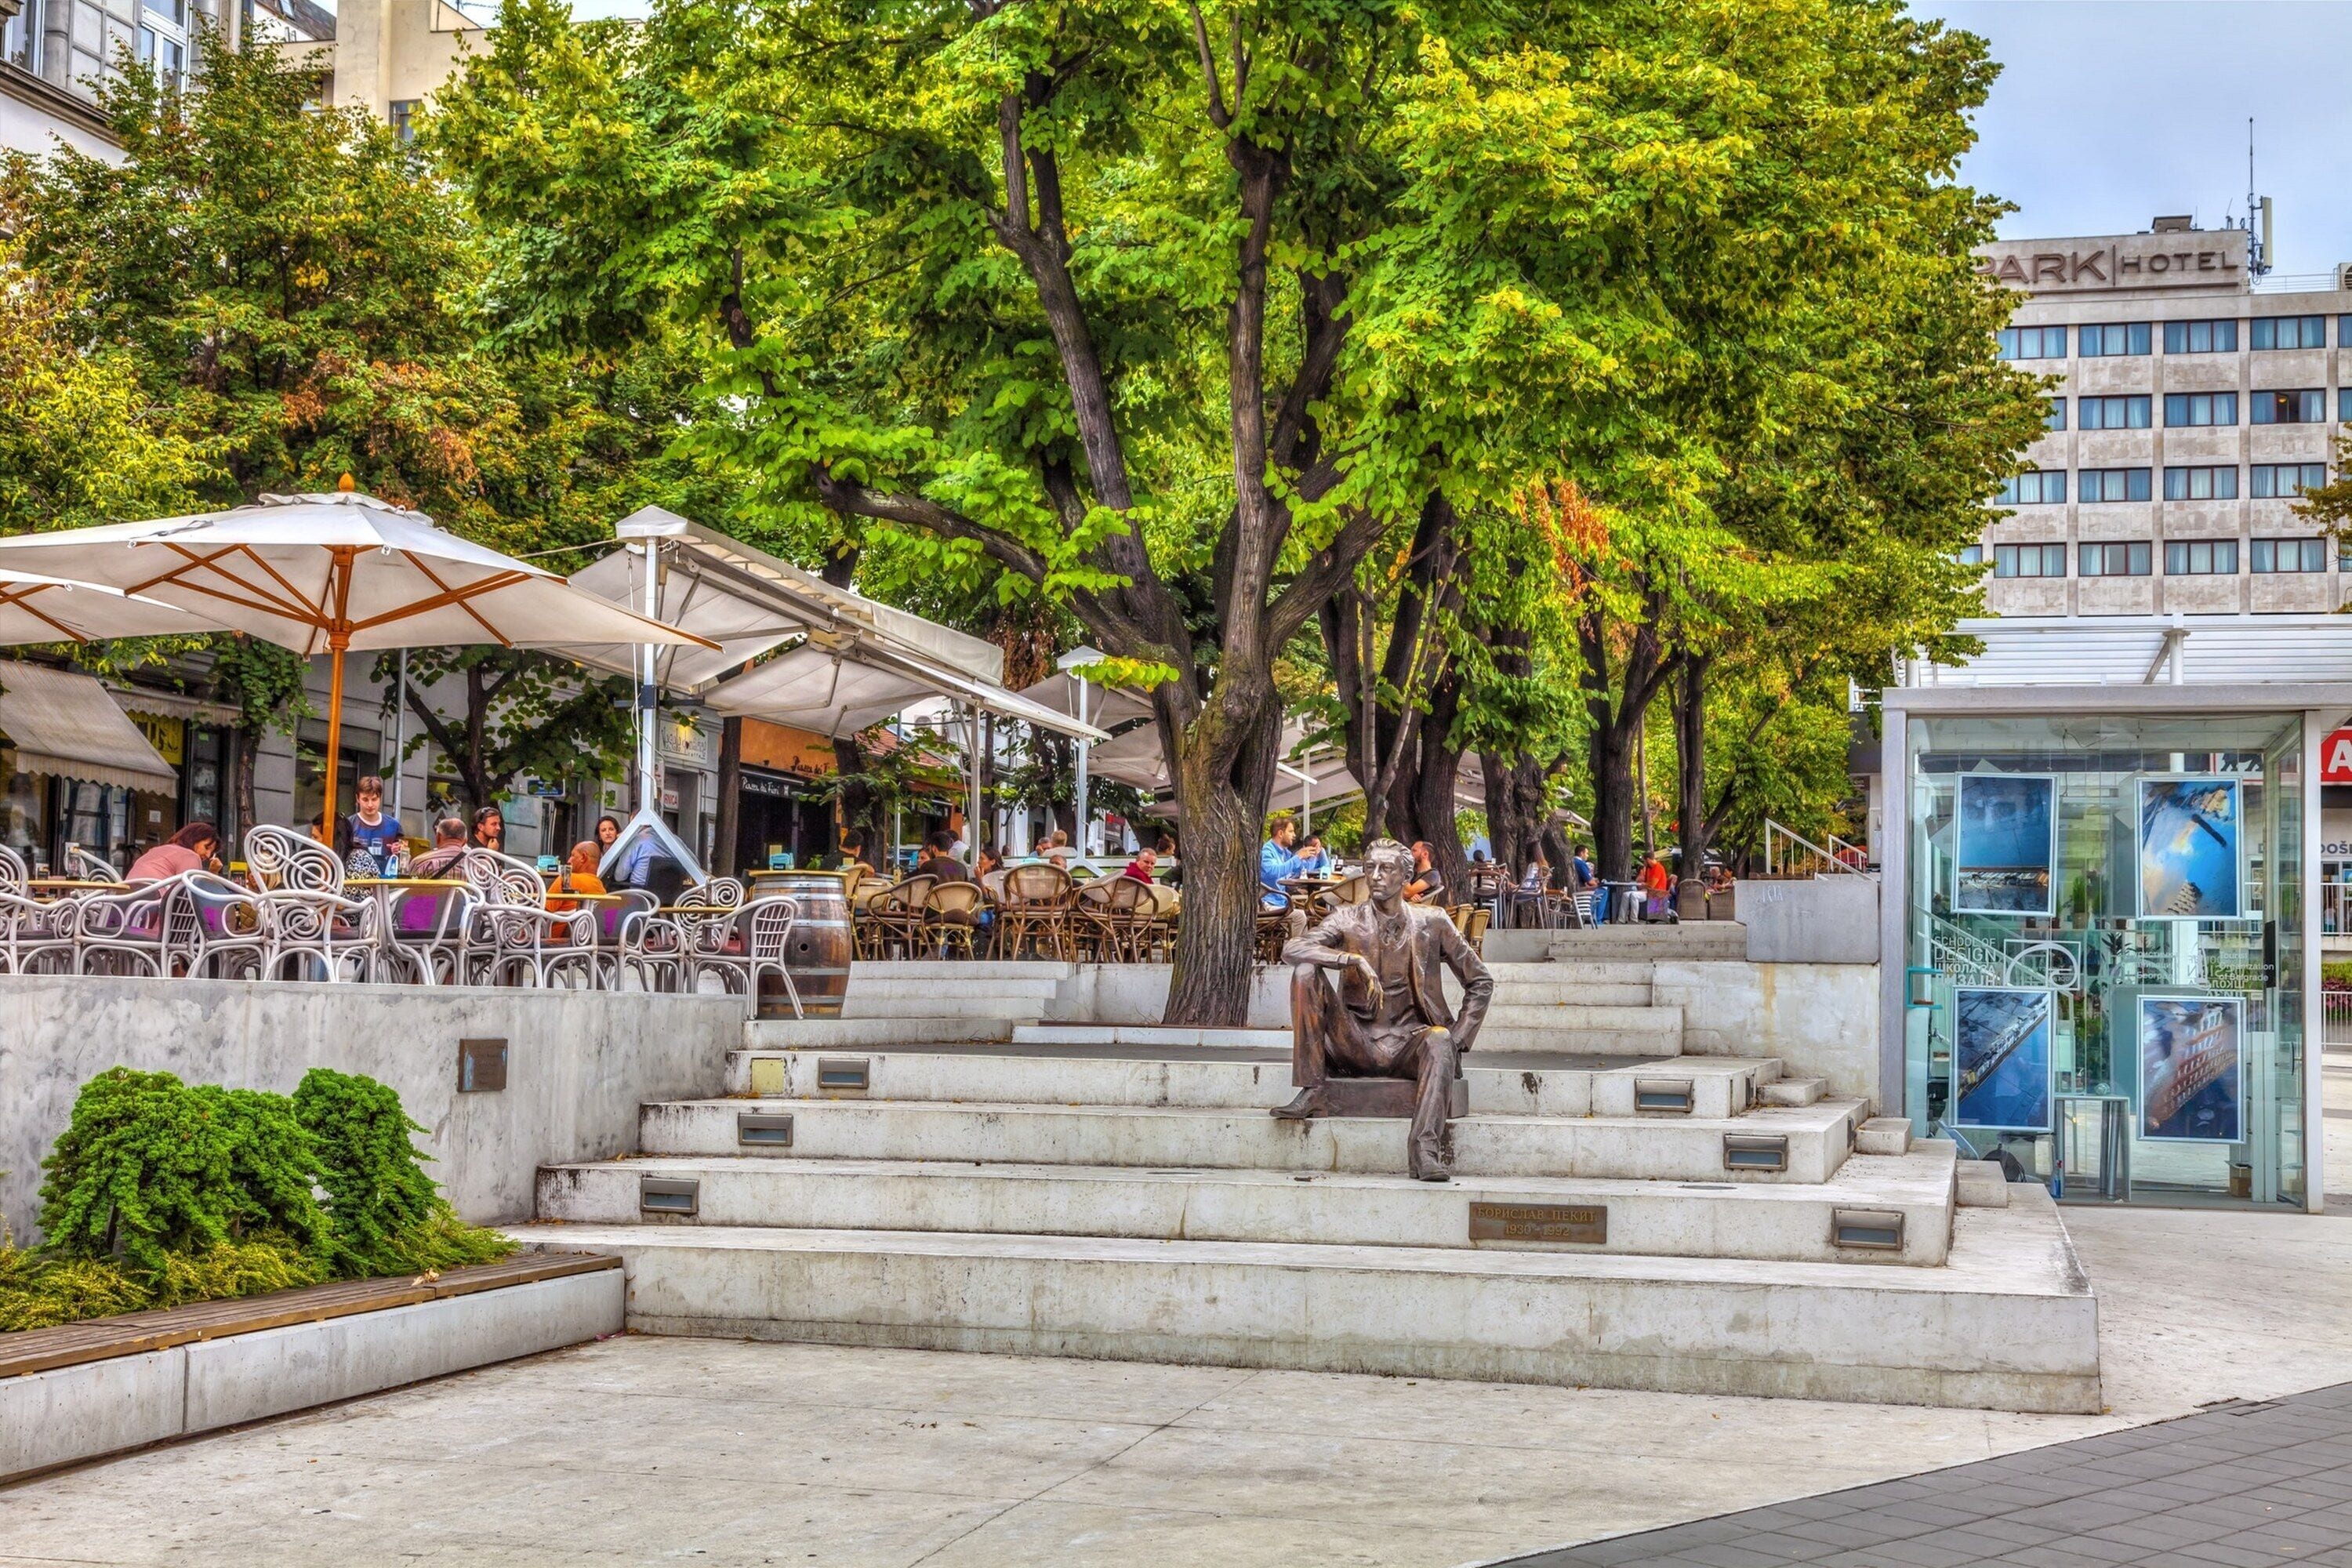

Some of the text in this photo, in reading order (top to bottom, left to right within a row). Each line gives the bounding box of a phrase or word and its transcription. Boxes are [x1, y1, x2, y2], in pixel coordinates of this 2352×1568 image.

[2122, 250, 2238, 274] HOTEL
[1934, 936, 1996, 947] SCHOOL OF
[1934, 946, 1997, 961] DESIGN
[2220, 962, 2274, 972] Organization
[2230, 973, 2269, 983] Belgrade
[1478, 1207, 1544, 1220] БОРИСЛАВ
[1505, 1224, 1530, 1235] 1930
[1544, 1225, 1570, 1236] 1992
